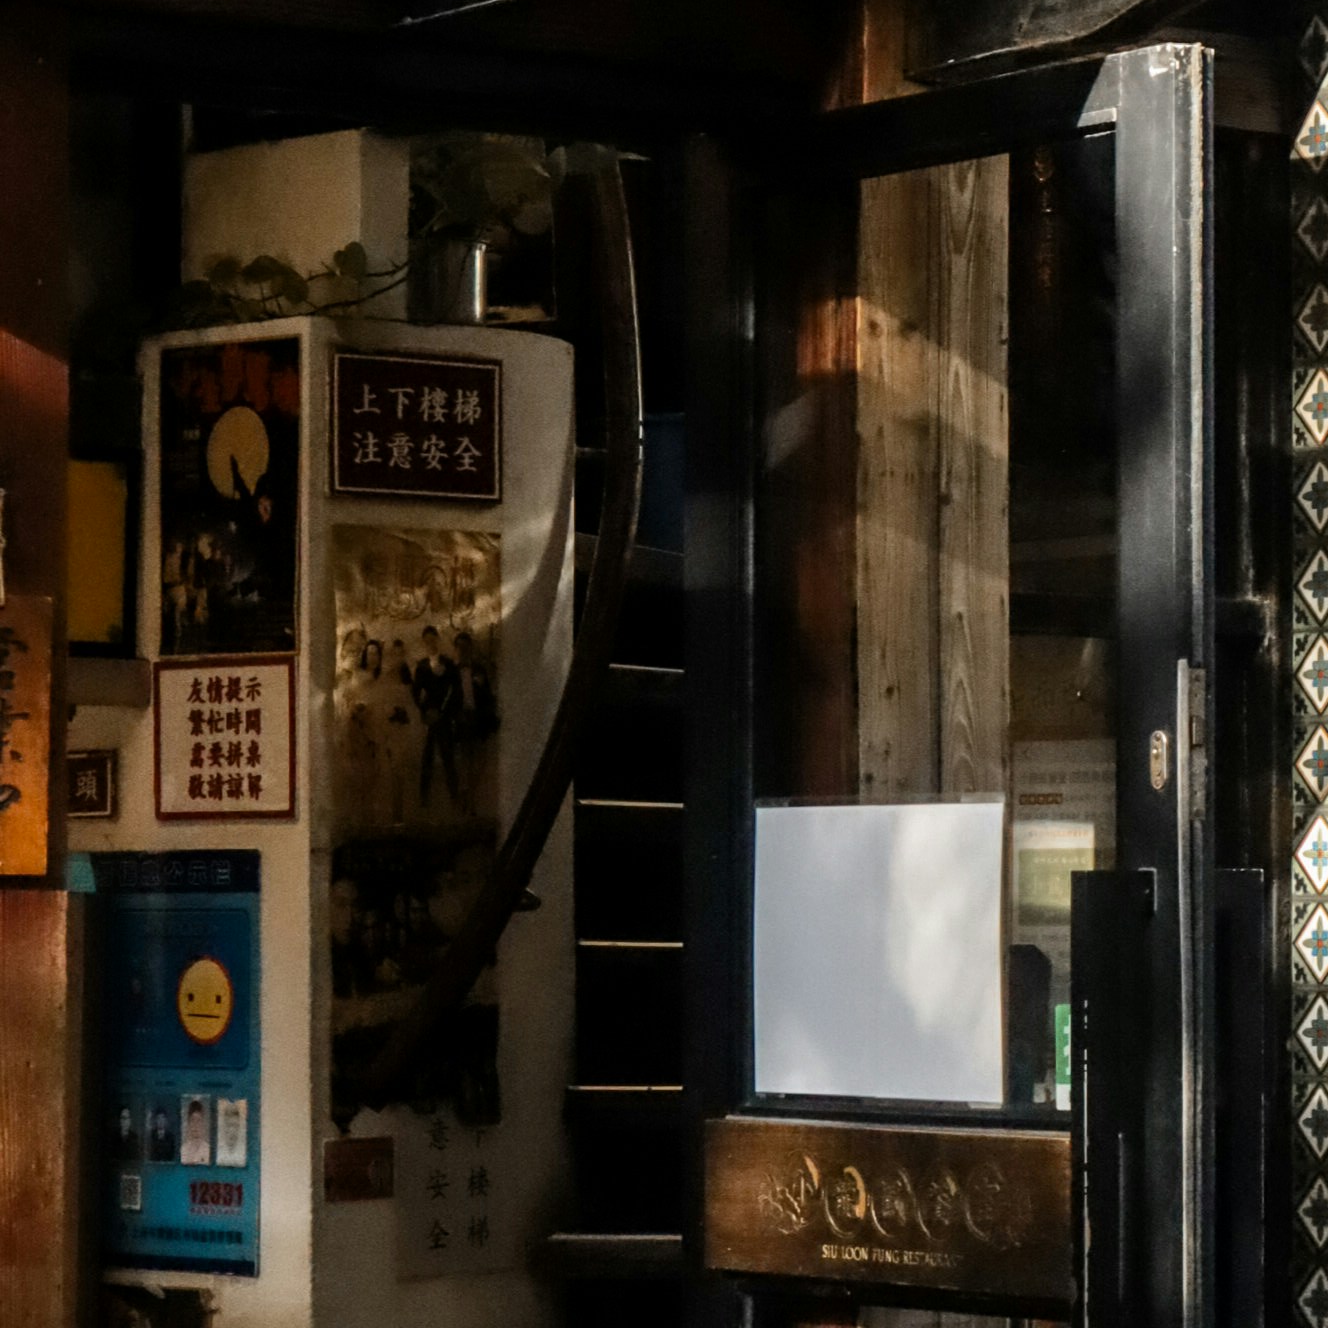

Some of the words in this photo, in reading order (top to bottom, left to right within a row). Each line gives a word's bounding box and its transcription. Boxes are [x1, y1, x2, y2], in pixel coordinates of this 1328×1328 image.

[352, 383, 482, 425] 上下樓梯
[352, 431, 482, 473] 注意安全
[187, 676, 262, 704] 友情提示
[188, 708, 261, 736] 繁忙時間
[190, 1182, 243, 1207] 12331
[821, 1244, 838, 1259] SIU
[841, 1246, 868, 1261] LOON
[872, 1248, 899, 1264] FUNG
